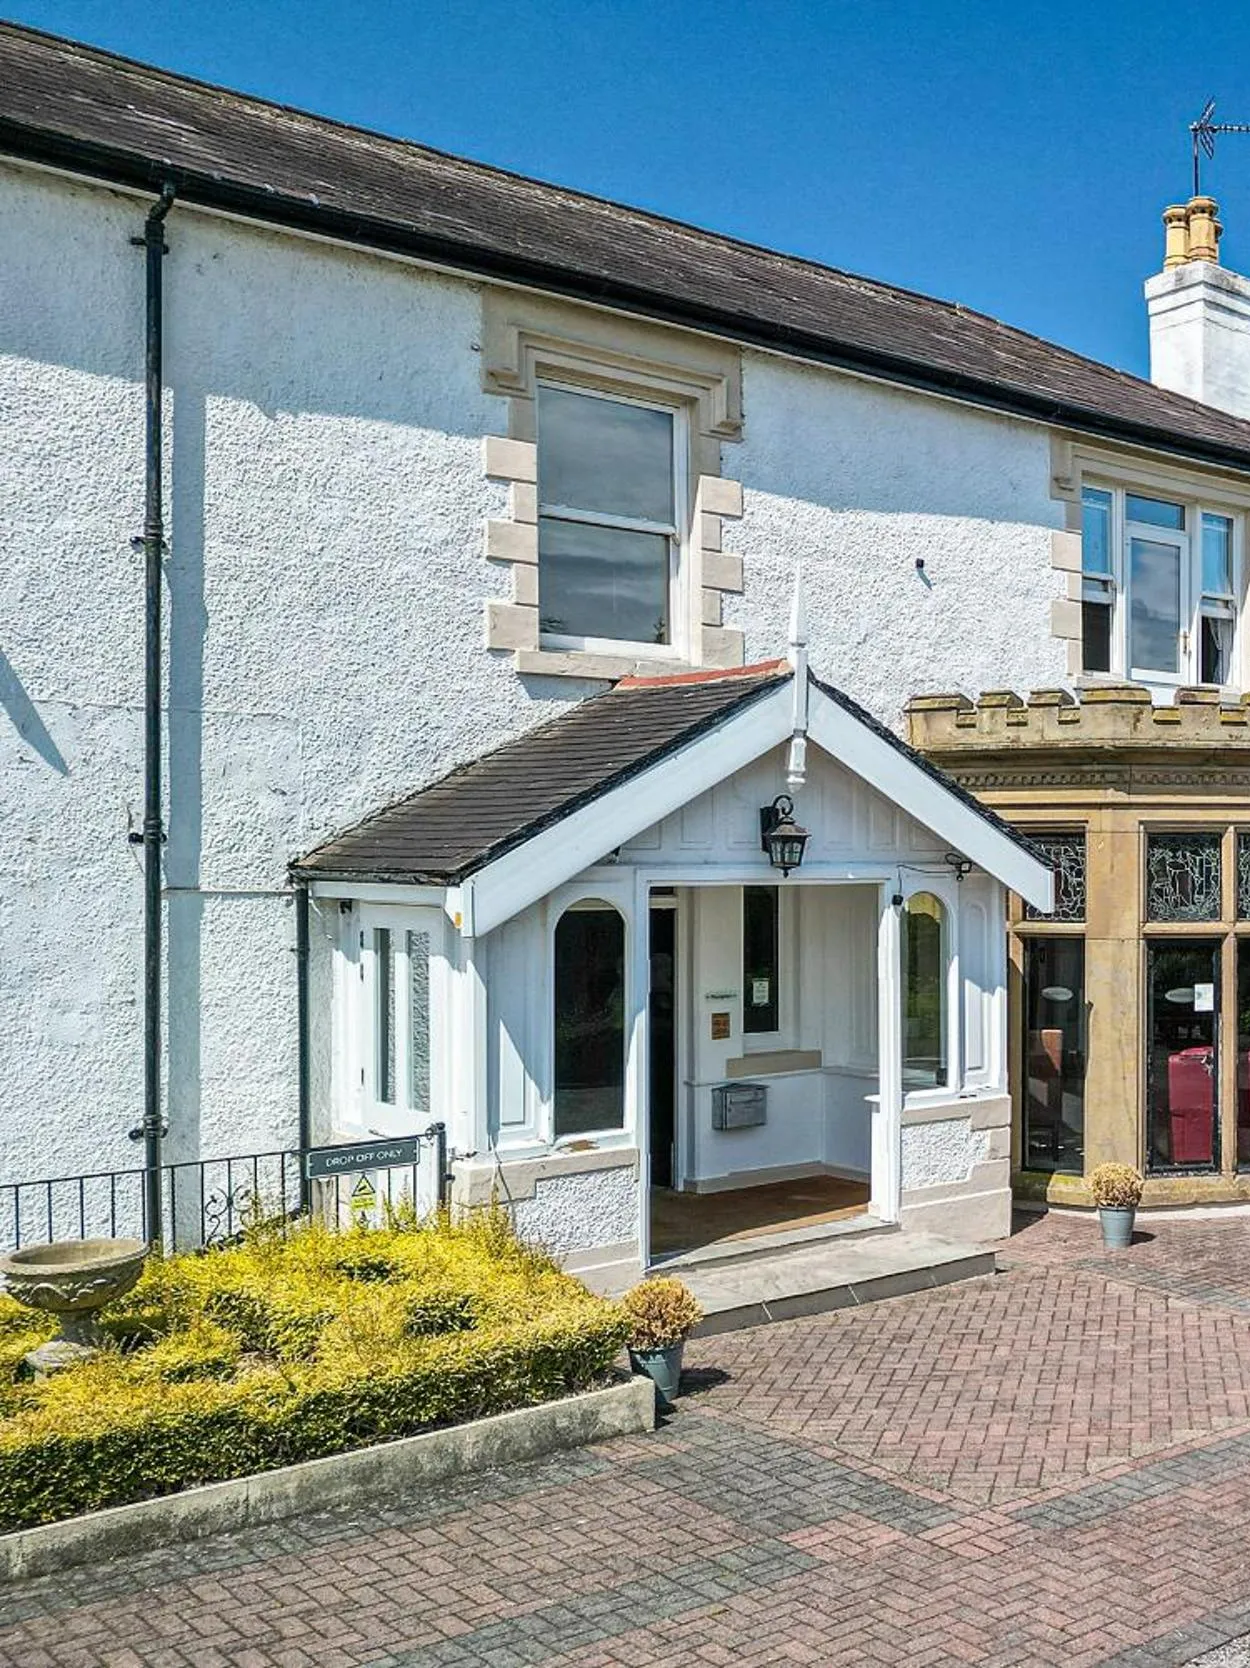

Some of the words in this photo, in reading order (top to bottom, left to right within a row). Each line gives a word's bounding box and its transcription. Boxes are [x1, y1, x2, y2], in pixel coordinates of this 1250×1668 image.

[326, 1155, 354, 1167] DROP
[356, 1153, 375, 1162] OFF
[376, 1149, 402, 1160] ONLY
